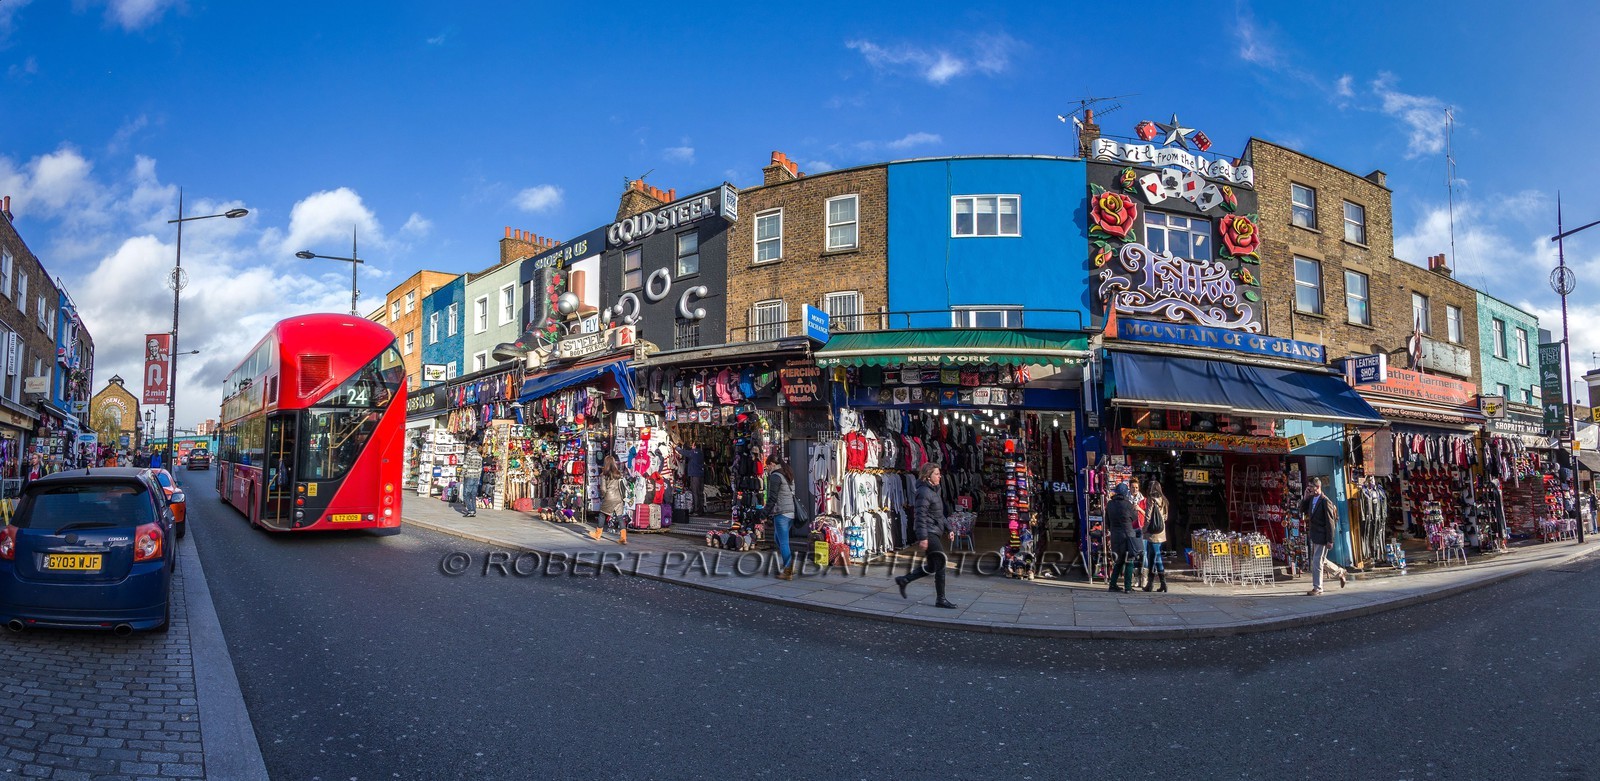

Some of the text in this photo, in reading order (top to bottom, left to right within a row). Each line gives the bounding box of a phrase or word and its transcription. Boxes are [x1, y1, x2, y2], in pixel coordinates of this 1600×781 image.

[1099, 140, 1249, 181] Evil from the Needle
[564, 246, 572, 261] R
[574, 239, 588, 257] US
[1119, 243, 1238, 308] Tattoo
[586, 318, 598, 332] FLY
[811, 314, 825, 325] MONEY
[808, 320, 829, 335] EXCHANGE
[564, 334, 605, 351] STEEL
[1126, 321, 1321, 359] MOUNTAIN OF OF JEANS
[569, 349, 584, 357] BODY
[1541, 352, 1559, 361] FISH
[1355, 356, 1380, 368] LEATHER
[780, 367, 820, 378] PIERCING
[1360, 367, 1376, 377] SHOP
[1386, 371, 1415, 382] ather
[1419, 374, 1463, 391] Garments
[784, 384, 817, 394] TATTOO
[1371, 384, 1416, 396] Souvenirs
[1416, 389, 1423, 397] &
[347, 388, 368, 405] 24
[425, 392, 435, 407] US
[1379, 406, 1400, 414] Leather
[1400, 409, 1424, 417] Garments
[1495, 421, 1525, 432] SHOPRITE
[1290, 436, 1300, 448] £1
[1197, 470, 1206, 480] £1
[1213, 543, 1223, 554] £1
[1255, 545, 1264, 556] £1
[50, 558, 76, 568] GY03
[78, 557, 100, 568] WJF
